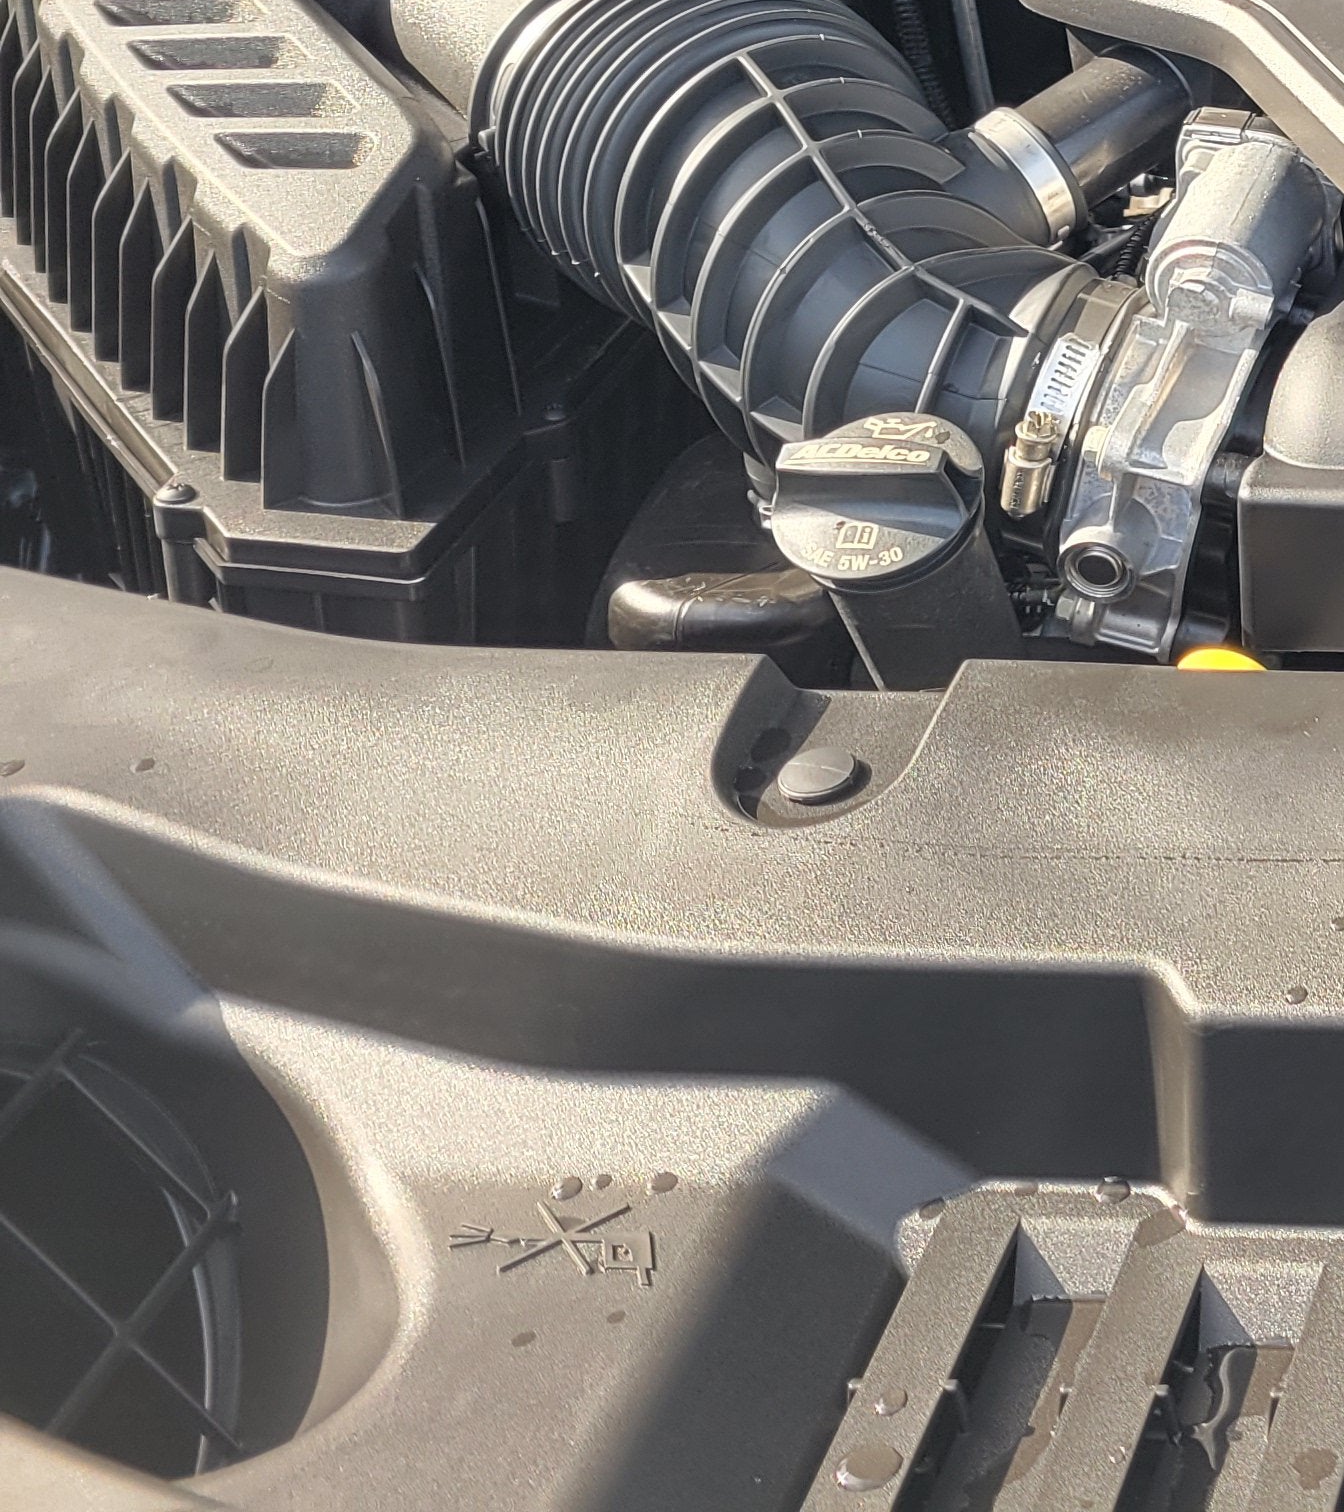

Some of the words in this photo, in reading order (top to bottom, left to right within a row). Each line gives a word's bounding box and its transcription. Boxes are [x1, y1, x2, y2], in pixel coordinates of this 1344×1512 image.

[790, 443, 930, 461] ACDelco
[802, 543, 833, 567] SAE
[838, 546, 903, 570] 5W-30
